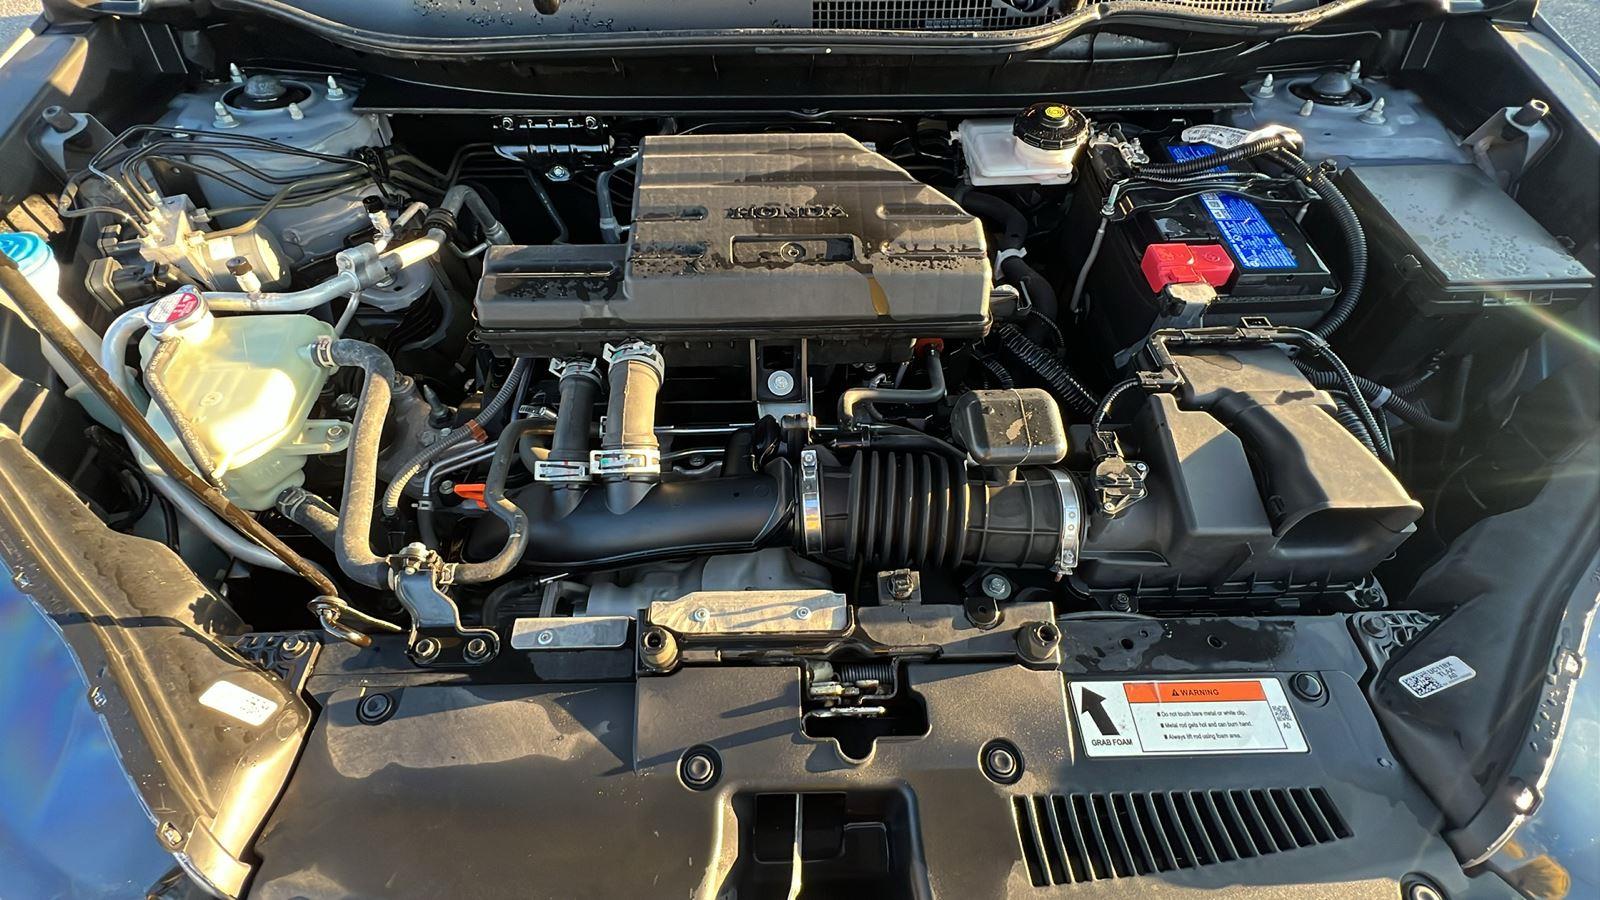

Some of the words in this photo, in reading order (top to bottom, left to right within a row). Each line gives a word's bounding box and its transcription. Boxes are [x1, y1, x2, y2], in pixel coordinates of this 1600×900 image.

[724, 204, 849, 219] HONDA
[1180, 688, 1220, 697] WARNING
[1169, 733, 1186, 741] Always
